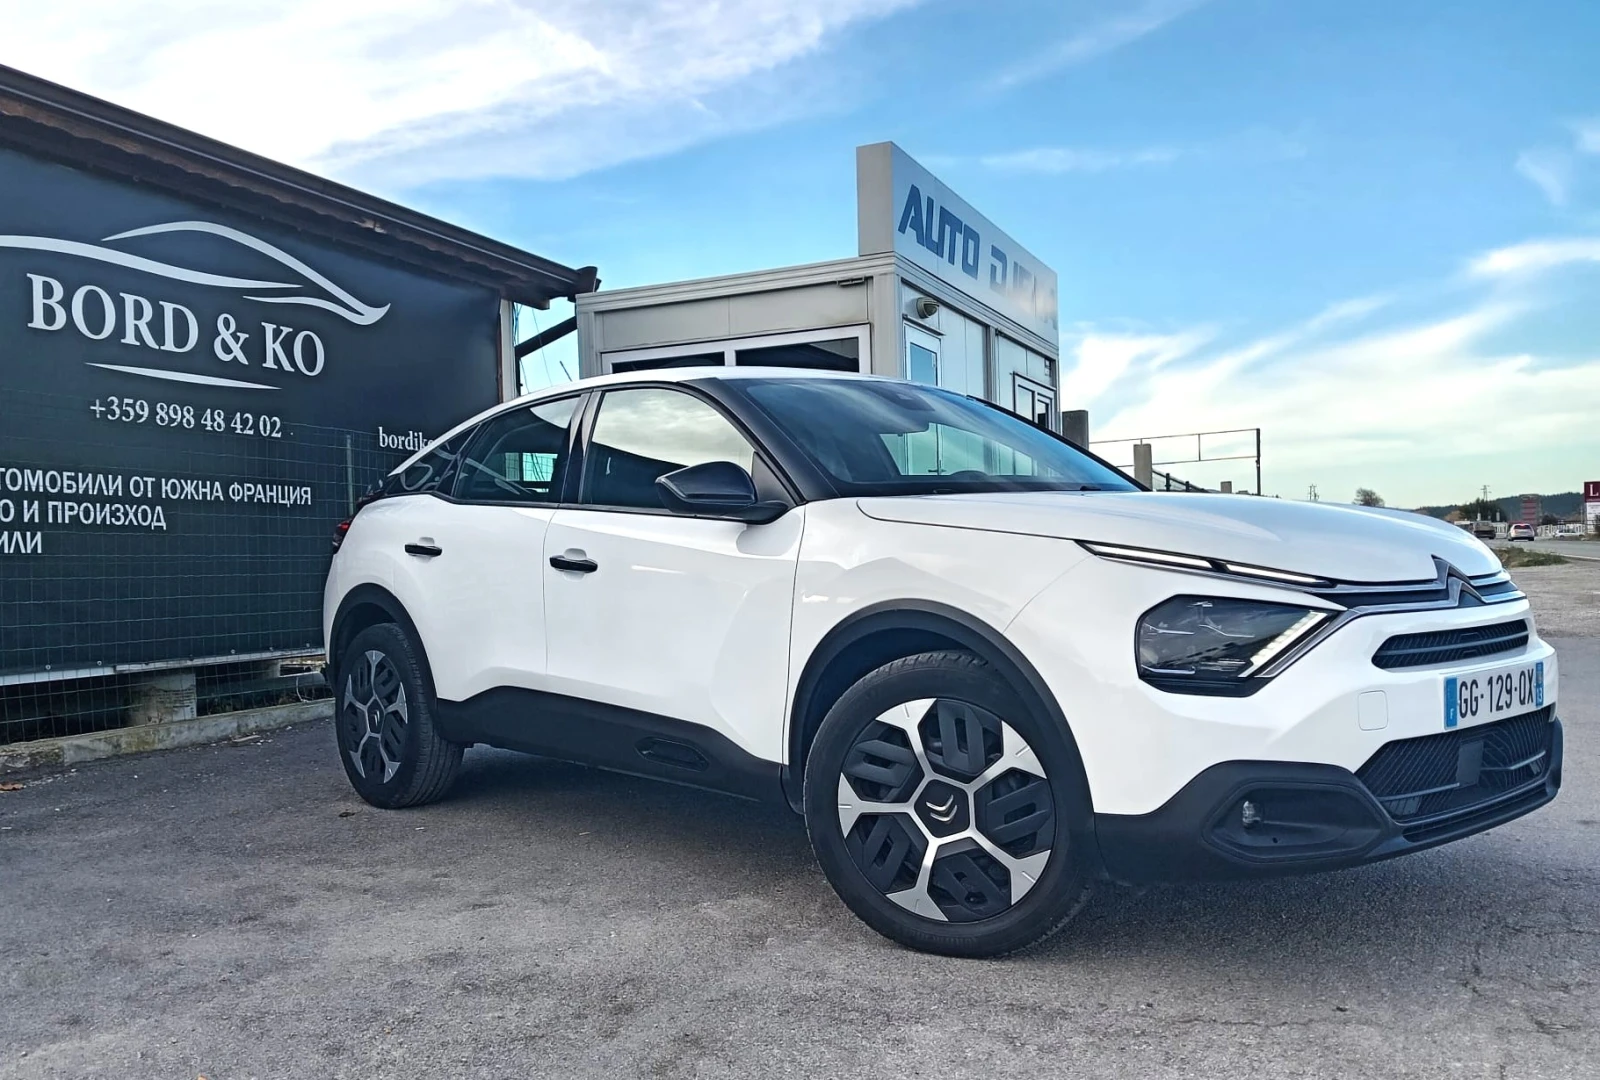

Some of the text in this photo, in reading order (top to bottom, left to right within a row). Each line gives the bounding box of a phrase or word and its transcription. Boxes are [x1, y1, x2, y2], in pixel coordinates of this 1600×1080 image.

[898, 184, 980, 280] AUTO
[26, 272, 325, 376] BORD & KO
[89, 396, 282, 438] +359 898 48 42 02
[129, 476, 156, 498] ОТ
[161, 478, 224, 501] ЮЖНА
[228, 481, 312, 506] ФРАНЦИЯ
[23, 500, 39, 523] И
[47, 501, 167, 530] ПРОИЗХОД
